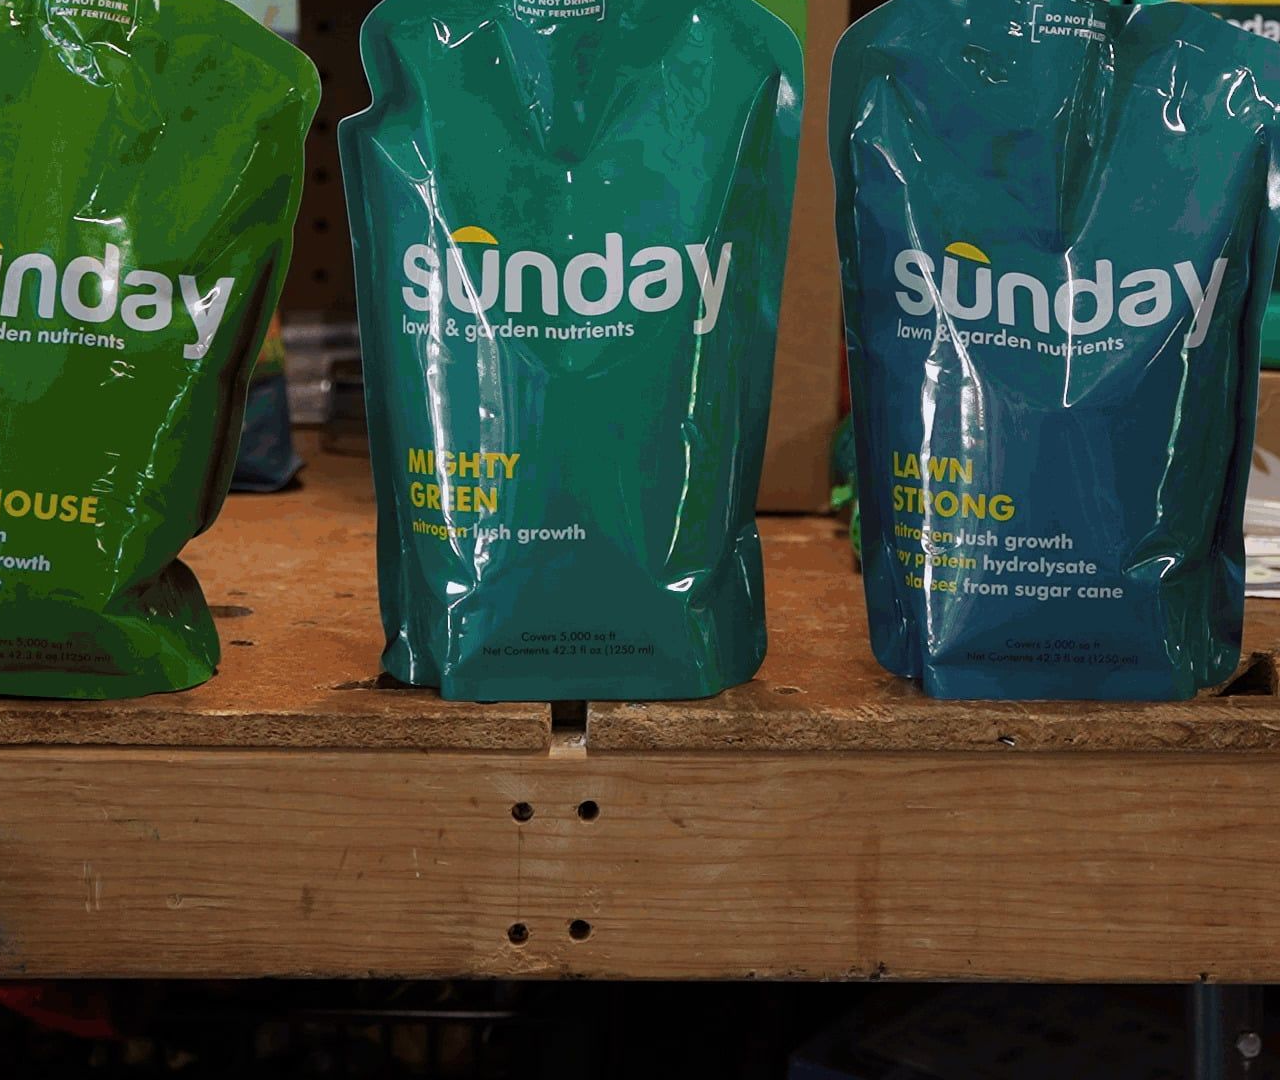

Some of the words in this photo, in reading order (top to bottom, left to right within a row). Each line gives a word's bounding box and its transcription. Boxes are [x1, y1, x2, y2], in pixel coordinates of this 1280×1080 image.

[82, 9, 131, 24] FERTILIZER
[98, 0, 129, 12] DRINK
[517, 5, 546, 18] PLANT
[548, 5, 601, 18] FERTILIZER
[1039, 25, 1072, 36] PLANT
[1045, 13, 1061, 23] DO
[1064, 15, 1086, 25] NOT
[401, 225, 734, 335] sunday
[894, 241, 1229, 348] sunday
[37, 327, 126, 351] nutrients
[403, 314, 439, 335] law
[445, 318, 460, 337] &
[465, 318, 539, 343] garden
[545, 321, 635, 340] nutrients
[896, 319, 932, 341] lawn
[937, 324, 951, 342] &
[958, 329, 1031, 349] garden
[1037, 336, 1125, 357] nutrients
[408, 447, 521, 480] MIGHTY
[892, 451, 973, 485] LAWN
[410, 482, 498, 514] GREEN
[892, 484, 1016, 522] STRONG
[473, 523, 512, 541] lush
[517, 523, 586, 545] growth
[895, 522, 953, 544] nitroen
[960, 528, 996, 547] lush
[1005, 533, 1074, 552] growth
[897, 549, 911, 566] oy
[915, 553, 977, 569] potein
[983, 551, 1097, 576] hydrolysate
[963, 578, 1008, 596] from
[1014, 582, 1070, 601] sugar
[1077, 585, 1124, 600] cane
[521, 631, 557, 642] Covers
[560, 631, 591, 643] 5,000
[594, 634, 606, 644] sq
[609, 631, 617, 641] ft
[1005, 638, 1041, 649] Covers
[482, 646, 502, 656] Net
[504, 646, 550, 657] Contents
[552, 645, 577, 655] 42.3
[589, 647, 602, 656] oz
[604, 644, 635, 656] (1250
[638, 644, 655, 656] ml)
